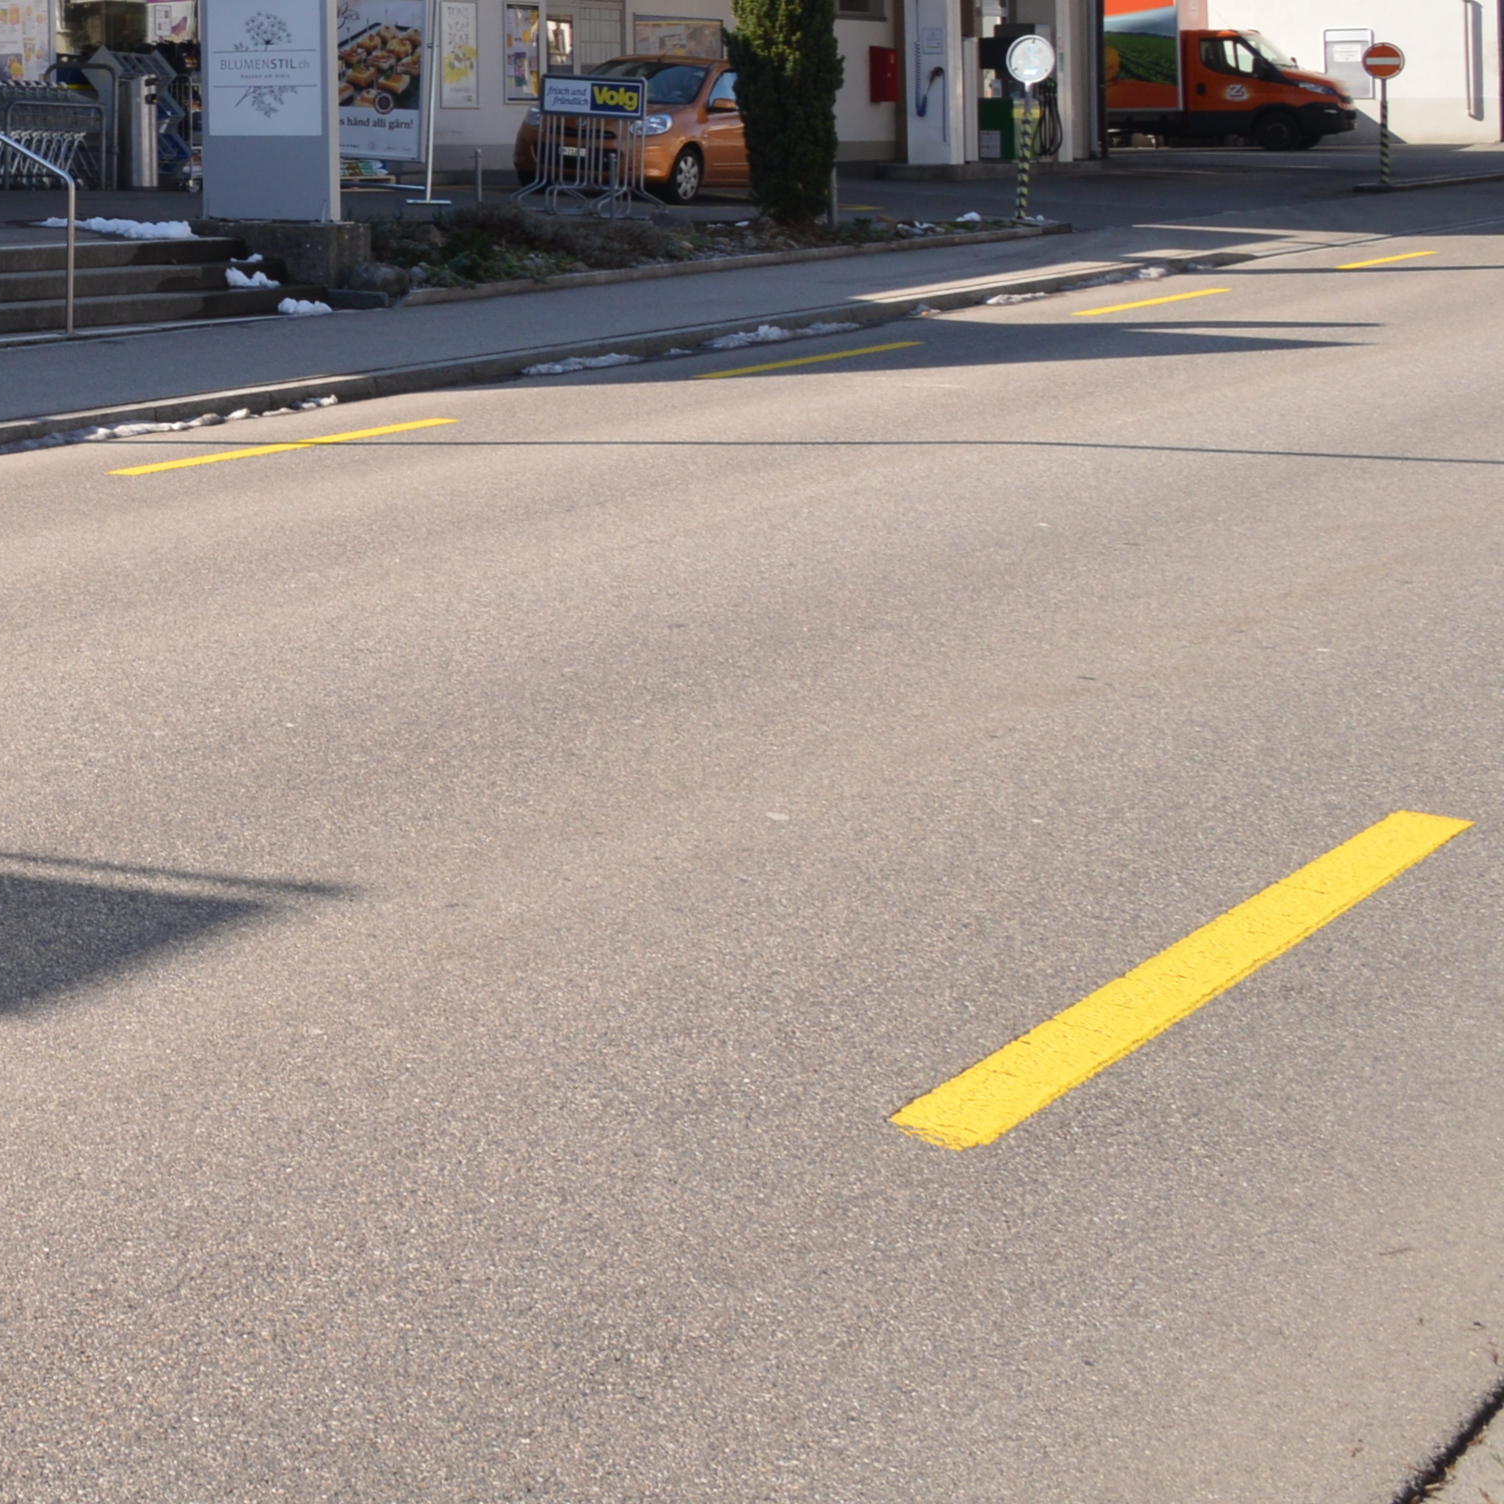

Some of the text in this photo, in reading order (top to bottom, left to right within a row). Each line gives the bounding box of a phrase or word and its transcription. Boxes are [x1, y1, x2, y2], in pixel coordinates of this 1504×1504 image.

[220, 58, 310, 71] BLUMENSTIL.ch
[547, 86, 587, 96] frisch und
[552, 96, 589, 106] fründlich
[593, 86, 639, 111] Volg
[347, 116, 370, 127] händ
[372, 117, 386, 128] alli
[388, 118, 414, 130] gärn!
